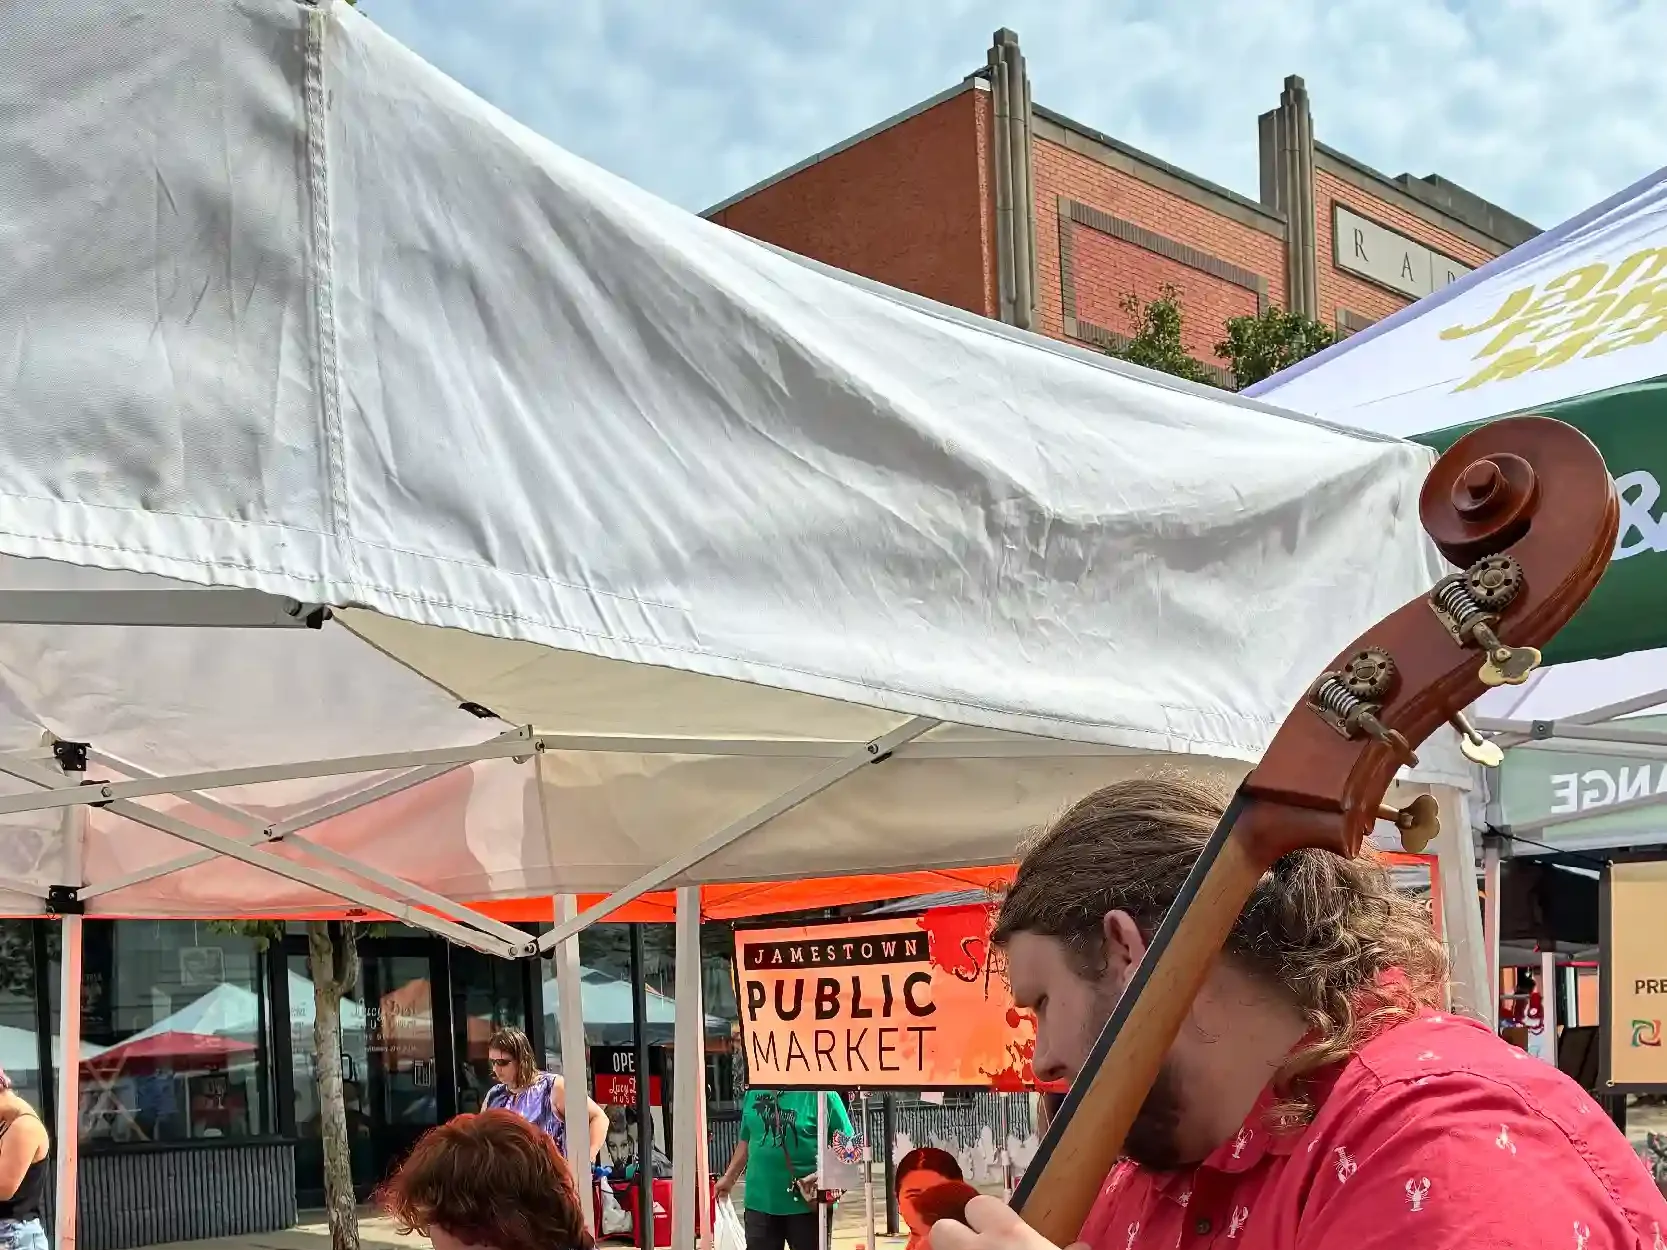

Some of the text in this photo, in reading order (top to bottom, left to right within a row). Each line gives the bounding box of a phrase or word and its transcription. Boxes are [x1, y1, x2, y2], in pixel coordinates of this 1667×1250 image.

[754, 939, 917, 964] JAMESTOWN
[747, 972, 936, 1021] PUBLIC
[752, 1026, 936, 1072] MARKET
